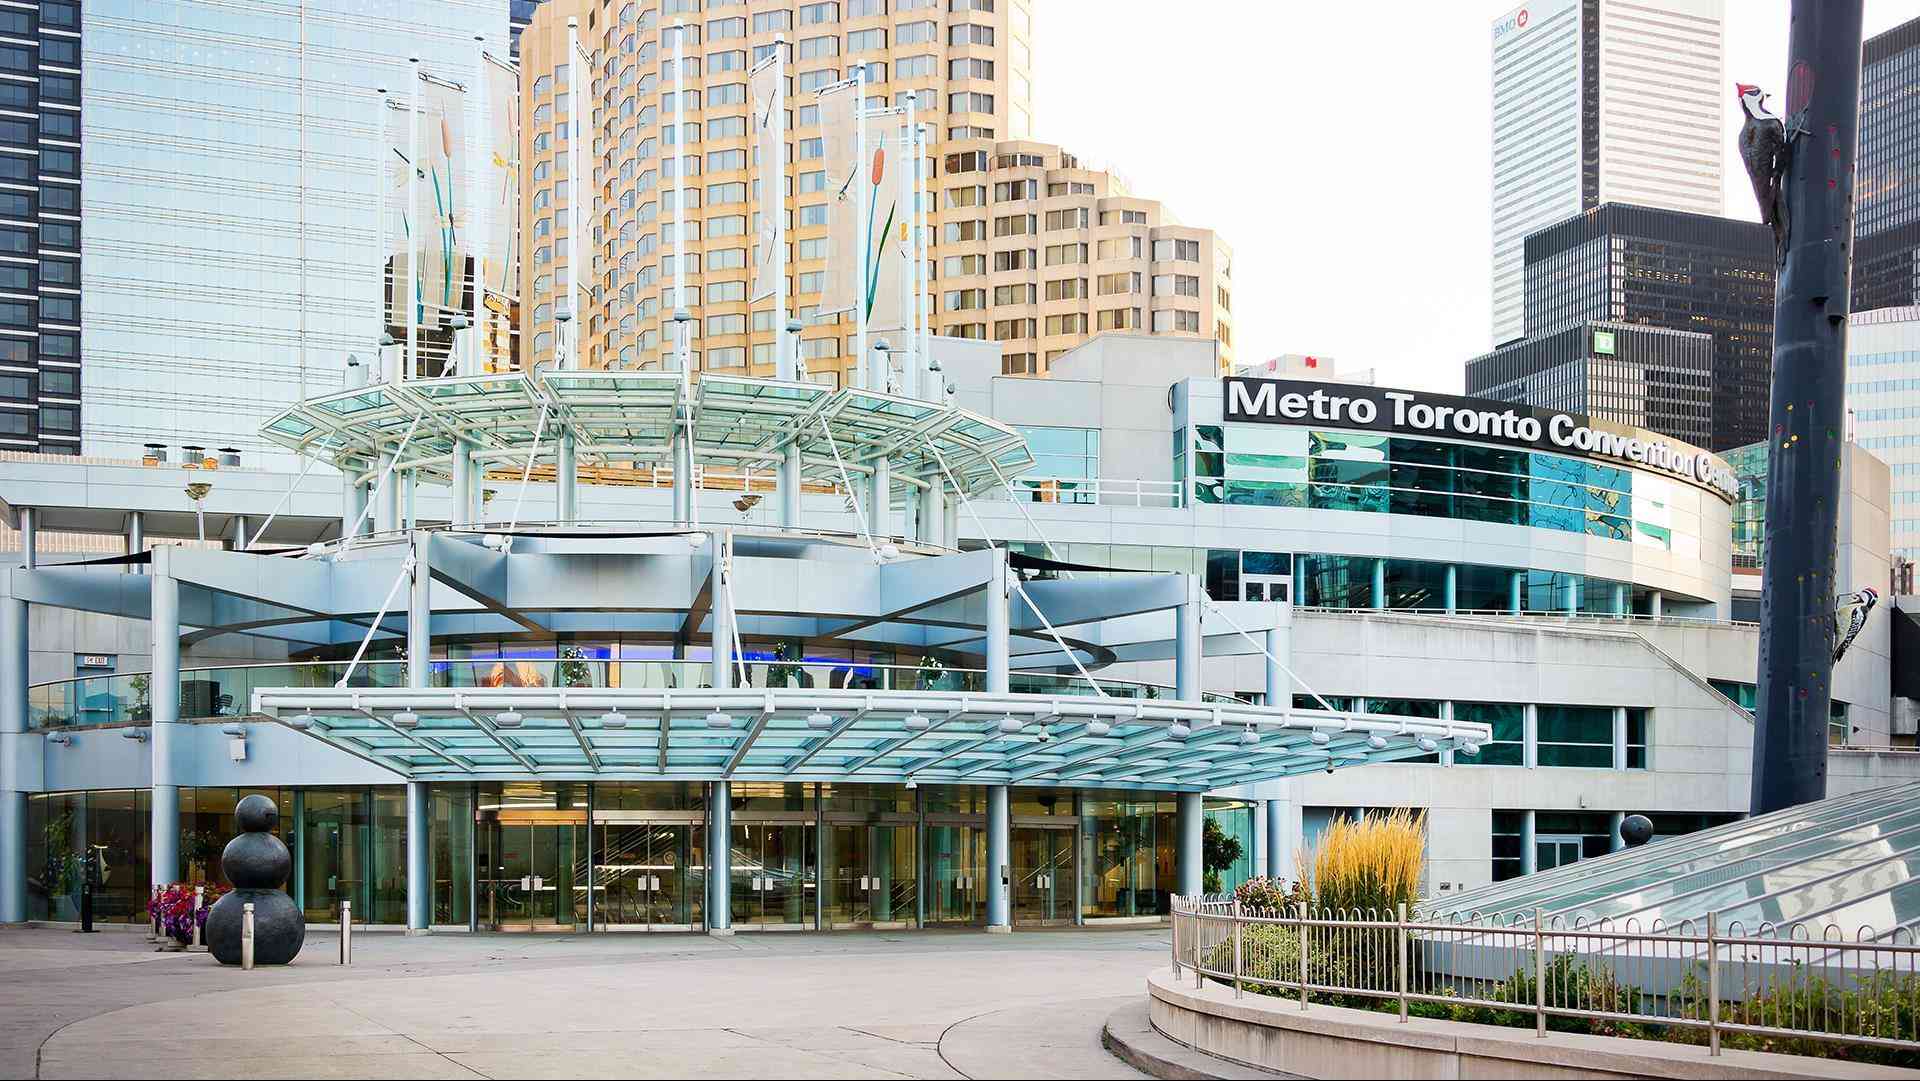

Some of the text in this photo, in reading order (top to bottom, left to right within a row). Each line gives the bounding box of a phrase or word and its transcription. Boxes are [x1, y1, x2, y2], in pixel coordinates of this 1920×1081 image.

[1228, 380, 1378, 424] Metro
[1384, 391, 1542, 442] Toronto
[1549, 413, 1696, 477] Convention
